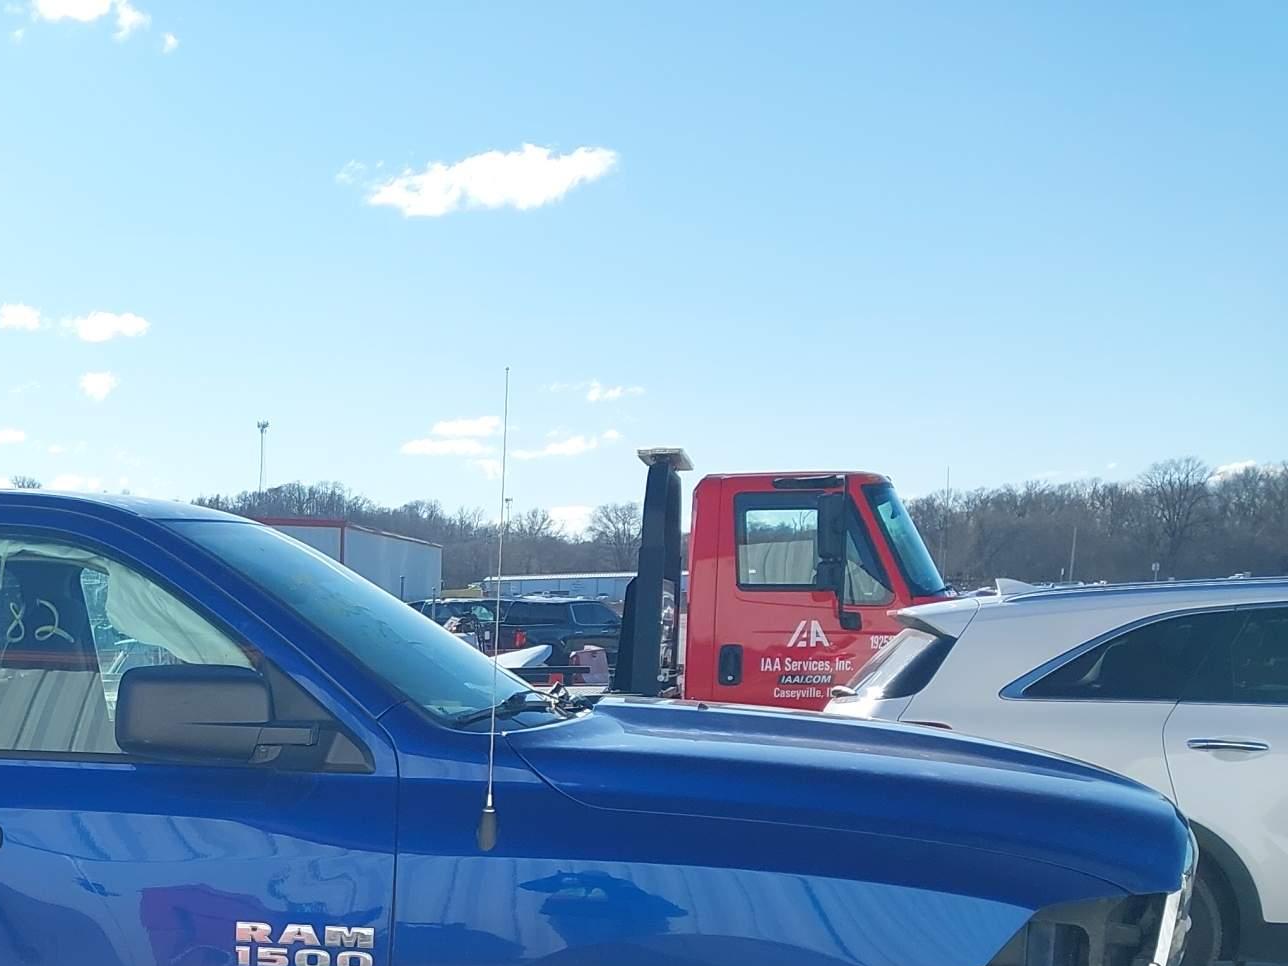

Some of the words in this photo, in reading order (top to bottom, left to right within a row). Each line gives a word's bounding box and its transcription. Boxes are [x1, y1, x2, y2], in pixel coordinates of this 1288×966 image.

[760, 657, 782, 672] IAA
[784, 657, 833, 673] Services,
[835, 656, 854, 672] Inc.
[235, 921, 375, 949] RAM
